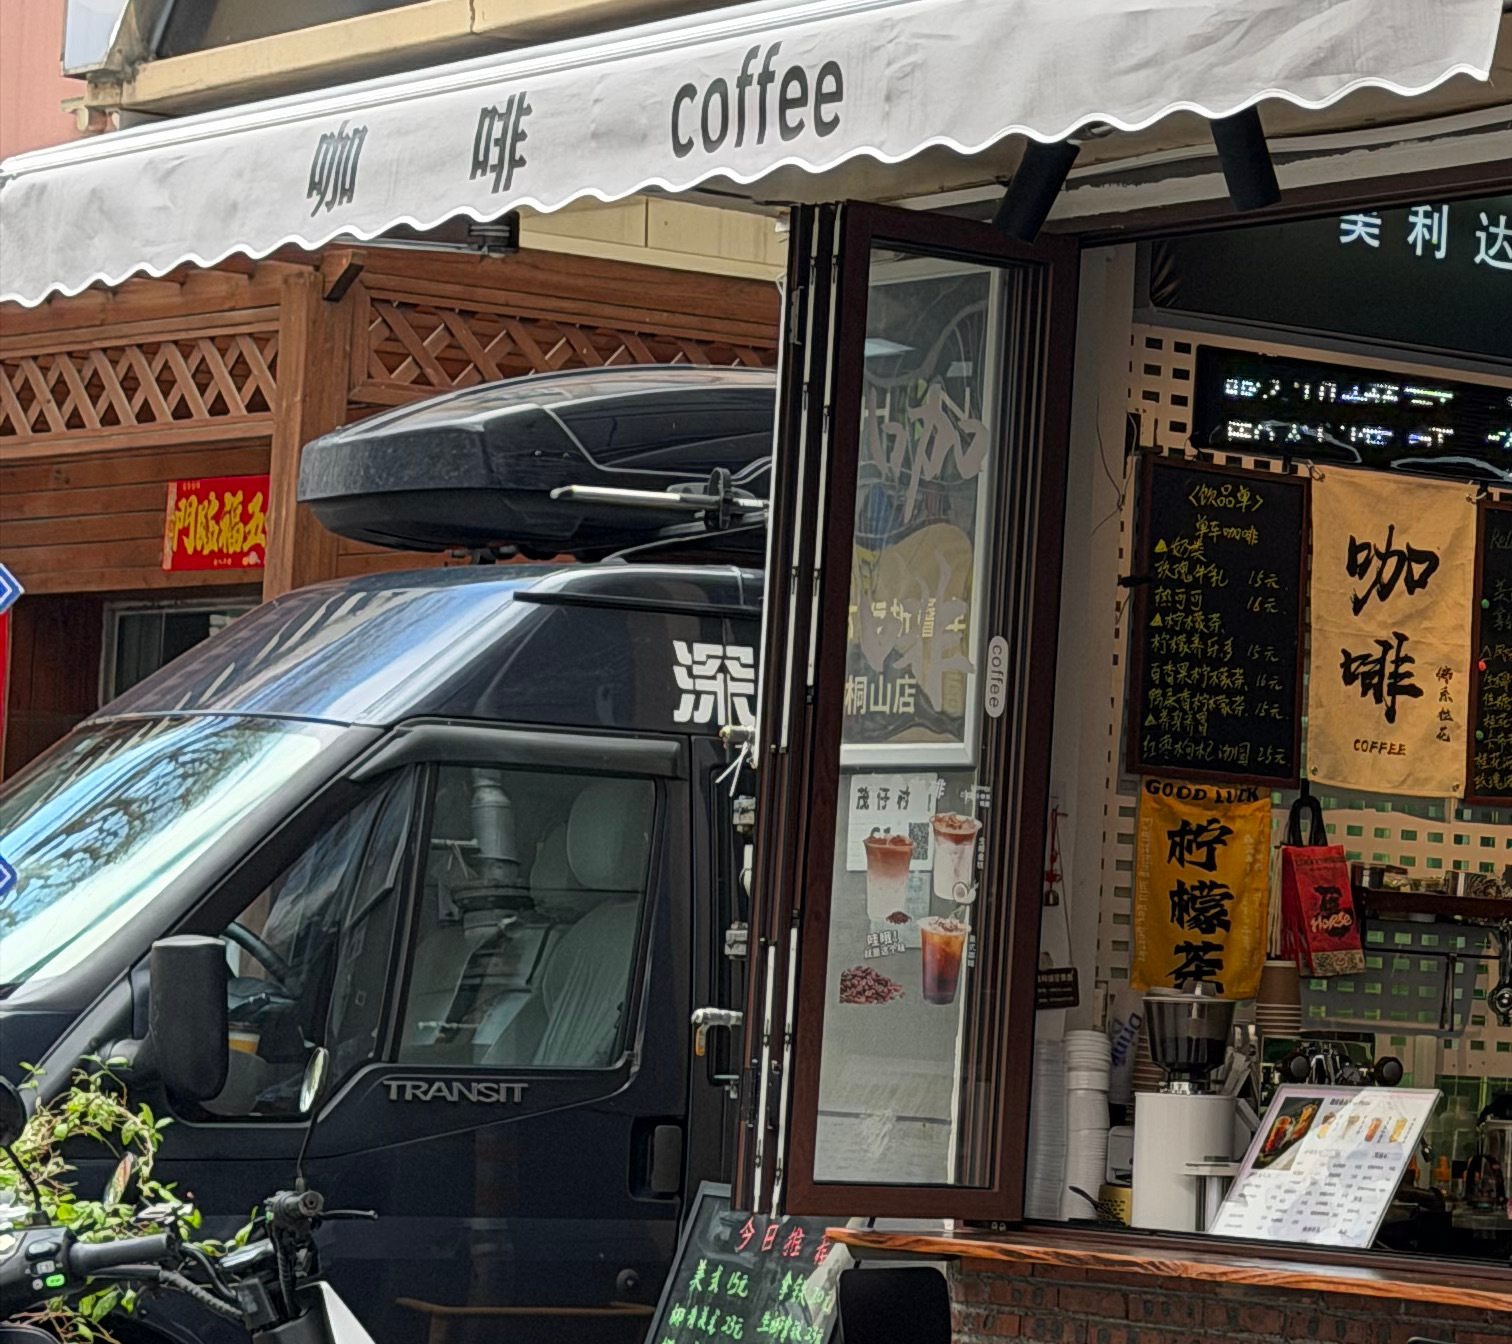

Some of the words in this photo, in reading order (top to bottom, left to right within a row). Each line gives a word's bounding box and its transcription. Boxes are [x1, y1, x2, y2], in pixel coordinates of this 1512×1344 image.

[670, 41, 845, 159] coffee
[306, 91, 534, 219] 咖啡
[1339, 523, 1441, 725] 咖啡
[672, 640, 756, 727] 深
[987, 643, 1005, 709] coffee
[1353, 738, 1407, 756] COFFEE
[1145, 778, 1208, 802] GOOD
[1214, 787, 1261, 805] LUCK
[1165, 816, 1236, 995] 柠檬茶
[384, 1080, 528, 1105] TRANSIT
